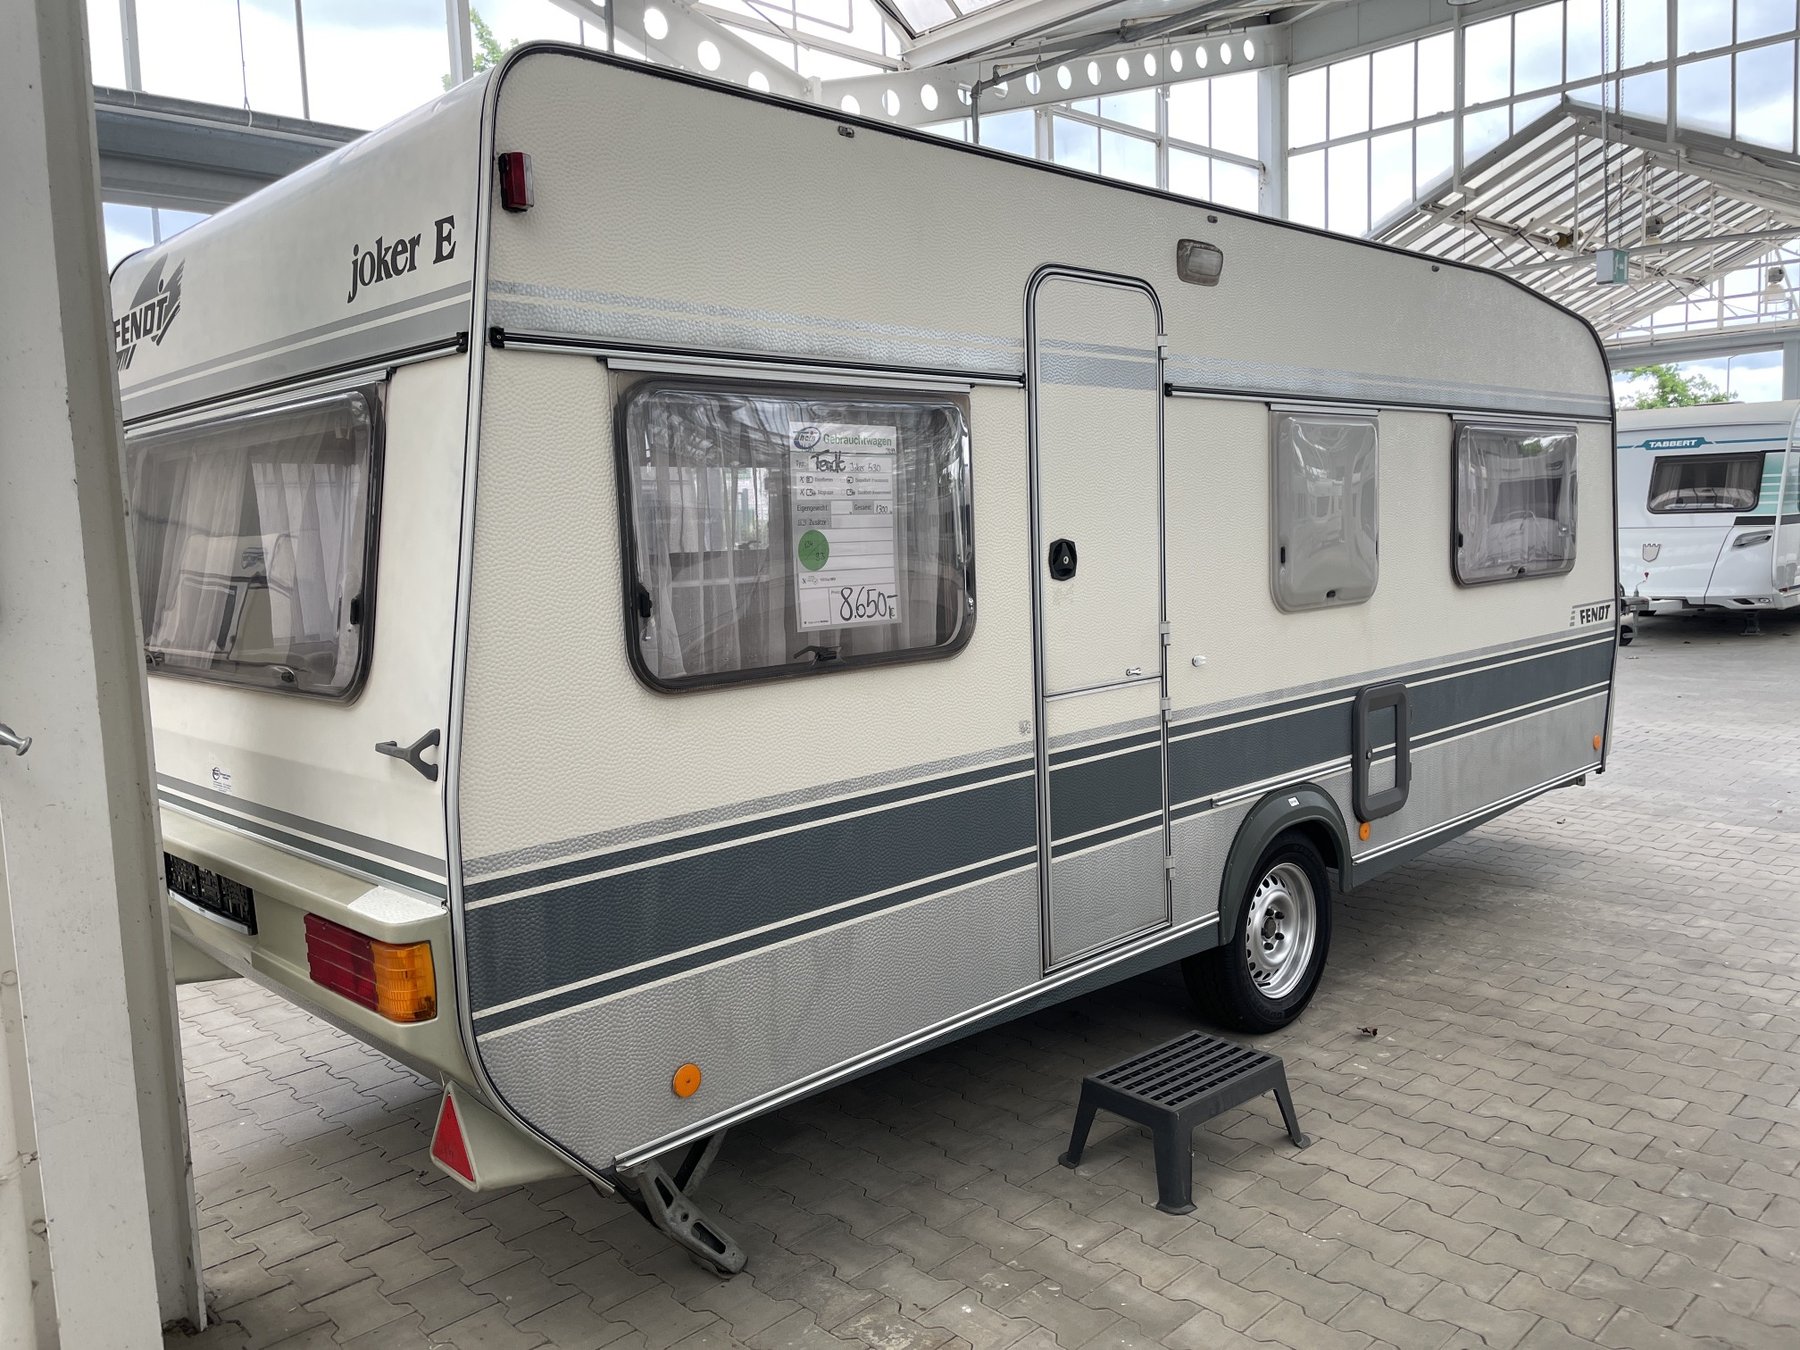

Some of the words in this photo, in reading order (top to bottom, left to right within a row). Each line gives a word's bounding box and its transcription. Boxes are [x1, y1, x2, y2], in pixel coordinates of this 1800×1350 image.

[347, 233, 421, 304] joker
[432, 215, 456, 265] E
[823, 433, 892, 447] Gebrauchtwagen
[1648, 439, 1698, 448] TABBERT
[1579, 604, 1611, 625] FENDT
